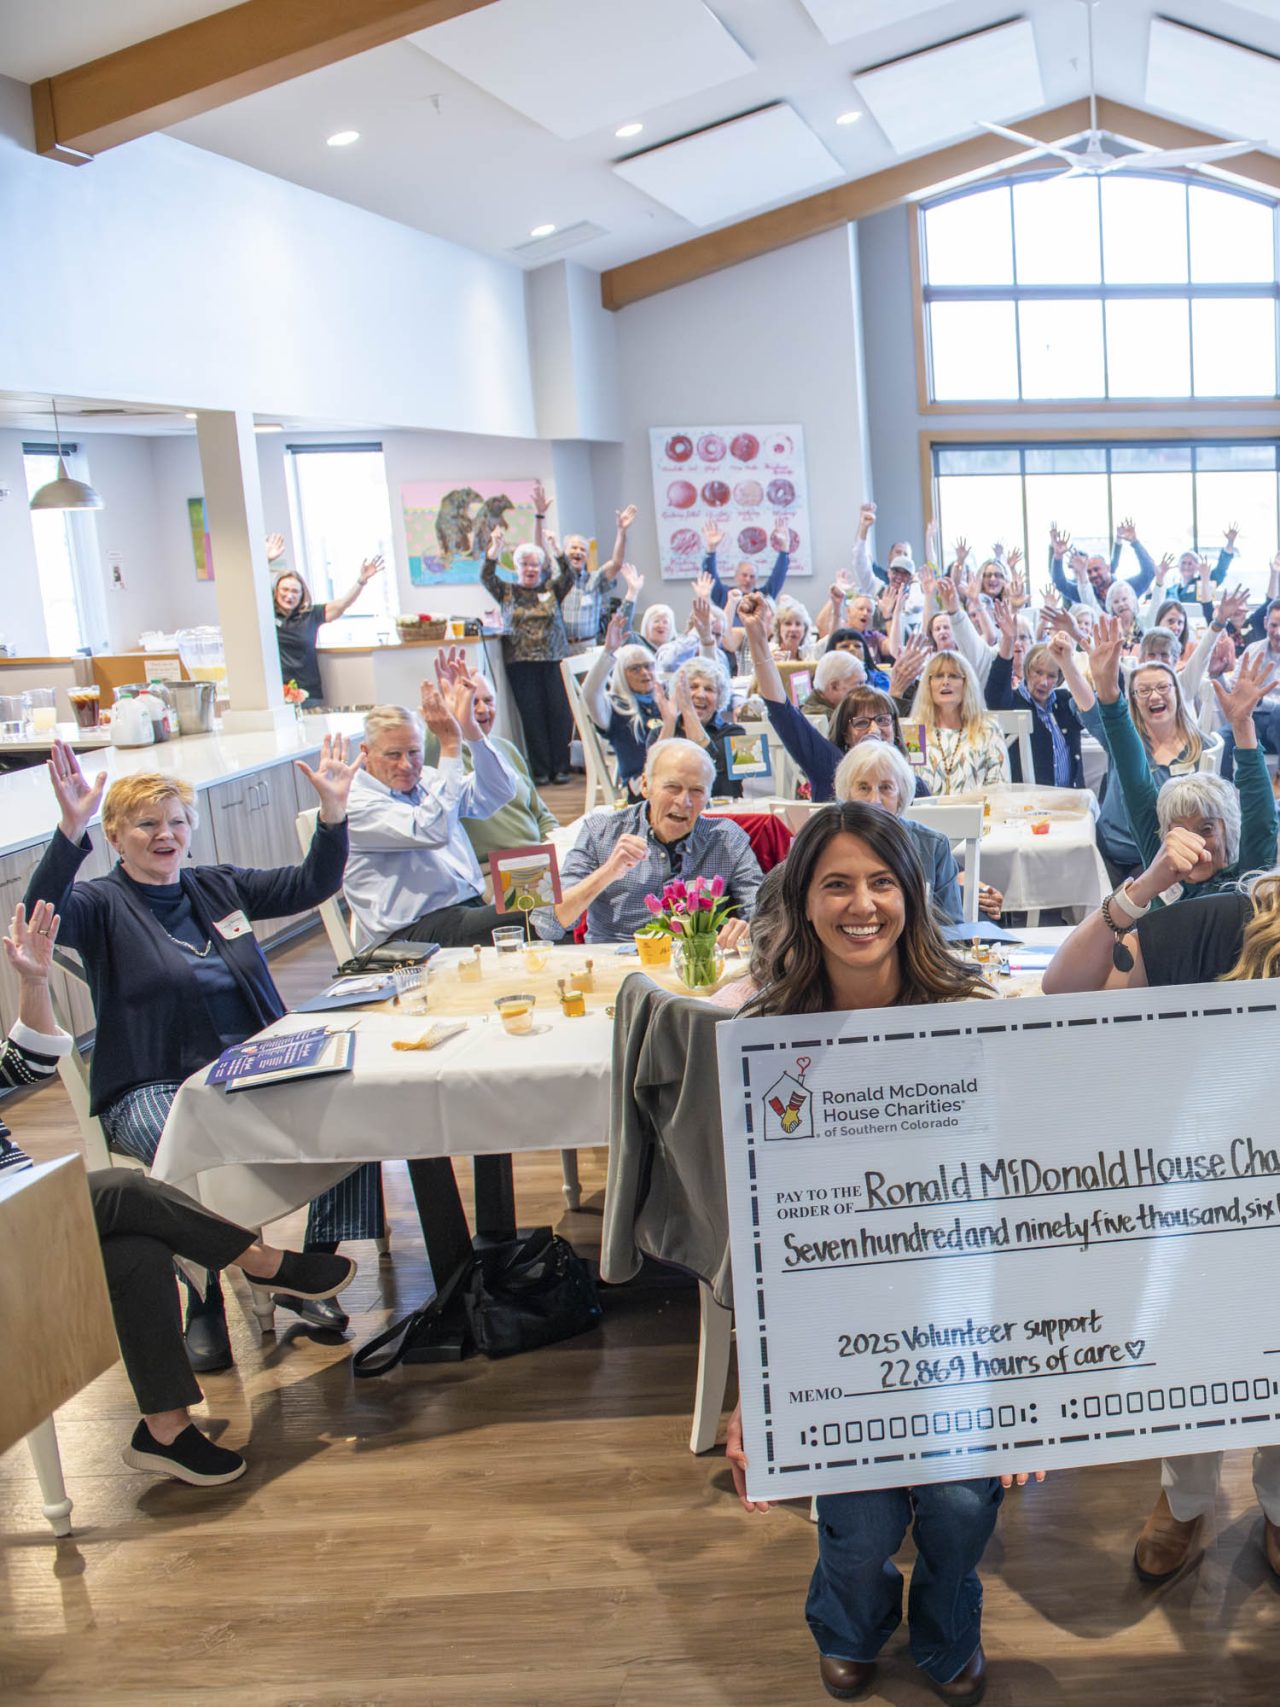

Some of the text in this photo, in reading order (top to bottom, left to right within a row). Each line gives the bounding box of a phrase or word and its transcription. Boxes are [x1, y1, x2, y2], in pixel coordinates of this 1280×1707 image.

[822, 1078, 978, 1105] Ronald McDonald
[824, 1099, 962, 1123] House Charities
[824, 1117, 959, 1137] of Southern Colorado
[865, 1162, 973, 1209] Ronald
[1134, 1147, 1226, 1185] House
[776, 1185, 862, 1204] PAY TO THE
[777, 1203, 854, 1220] ORDER OF
[838, 1309, 1102, 1358] 2025 Volunteer support
[973, 1350, 1040, 1379] hours
[1045, 1349, 1066, 1374] of
[1074, 1342, 1126, 1367] care
[789, 1386, 843, 1405] MEMO
